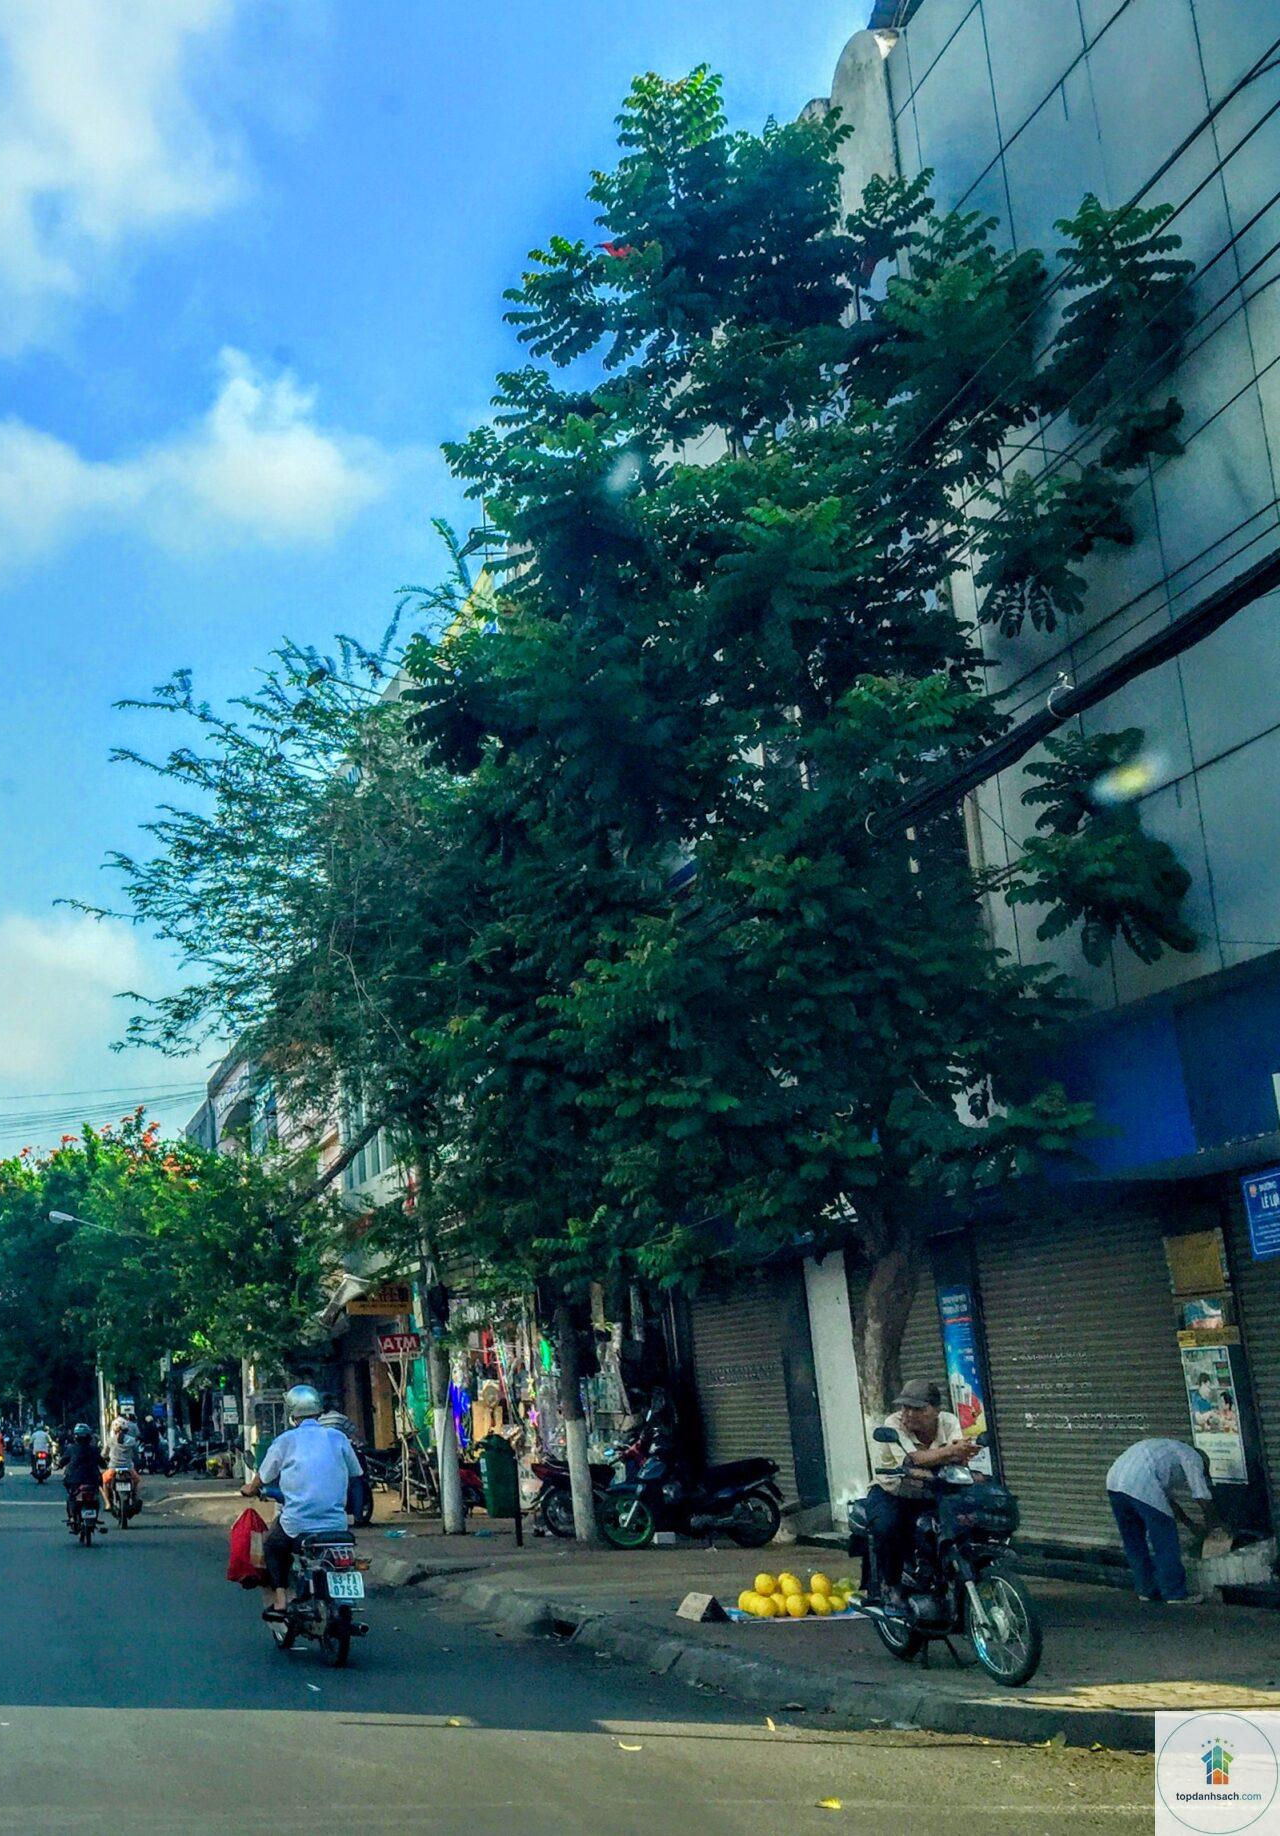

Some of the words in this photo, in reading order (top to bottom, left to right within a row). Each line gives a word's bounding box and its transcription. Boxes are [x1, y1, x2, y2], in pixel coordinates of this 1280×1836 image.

[1261, 1191, 1270, 1209] LÊ
[383, 1335, 418, 1350] ATM
[333, 1585, 359, 1596] 0755
